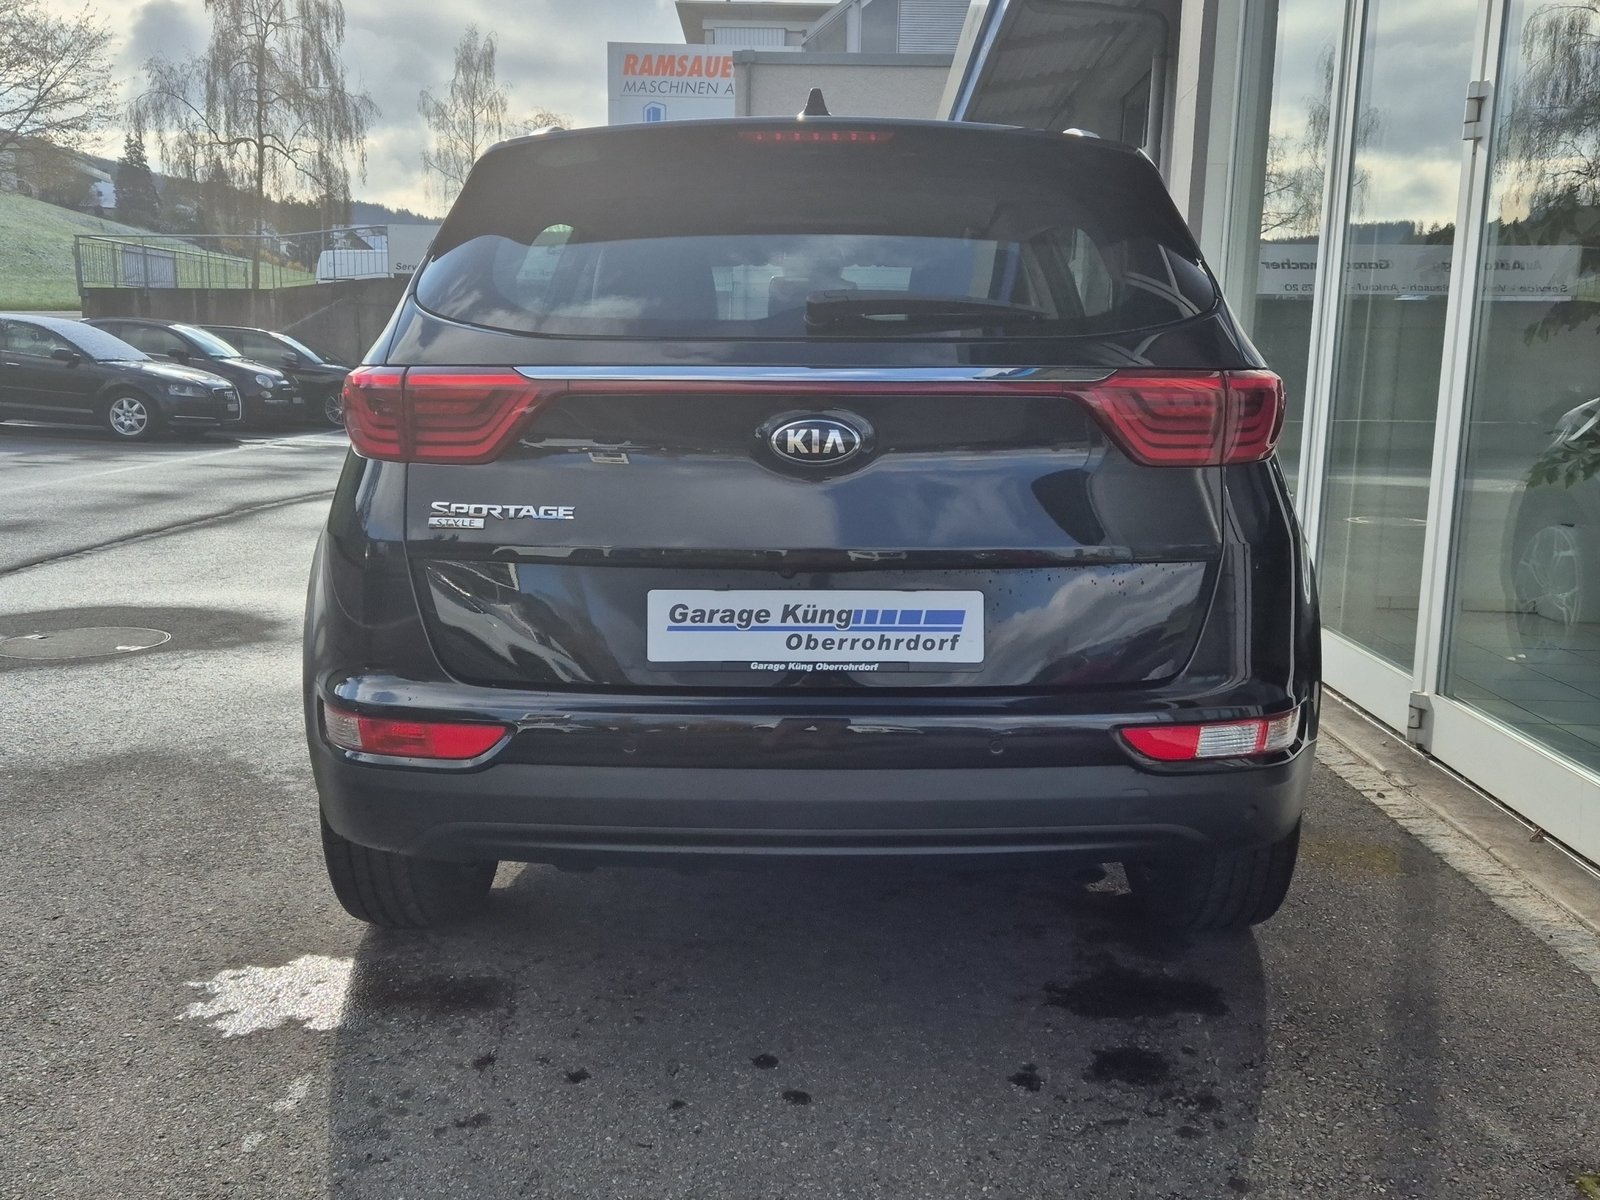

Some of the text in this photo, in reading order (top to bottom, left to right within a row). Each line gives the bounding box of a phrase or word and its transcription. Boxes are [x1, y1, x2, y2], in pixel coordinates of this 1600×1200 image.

[623, 54, 735, 78] RAMSAUE
[623, 80, 719, 95] MASCHINEN
[395, 262, 419, 271] Serv
[786, 429, 846, 454] KIA
[430, 501, 576, 520] SPORTAGE
[436, 518, 476, 528] STYLE
[668, 604, 853, 629] Garage Küng
[785, 633, 960, 651] Oberrohrdorf
[750, 662, 880, 672] Garage Küng Oberrohrdorf
